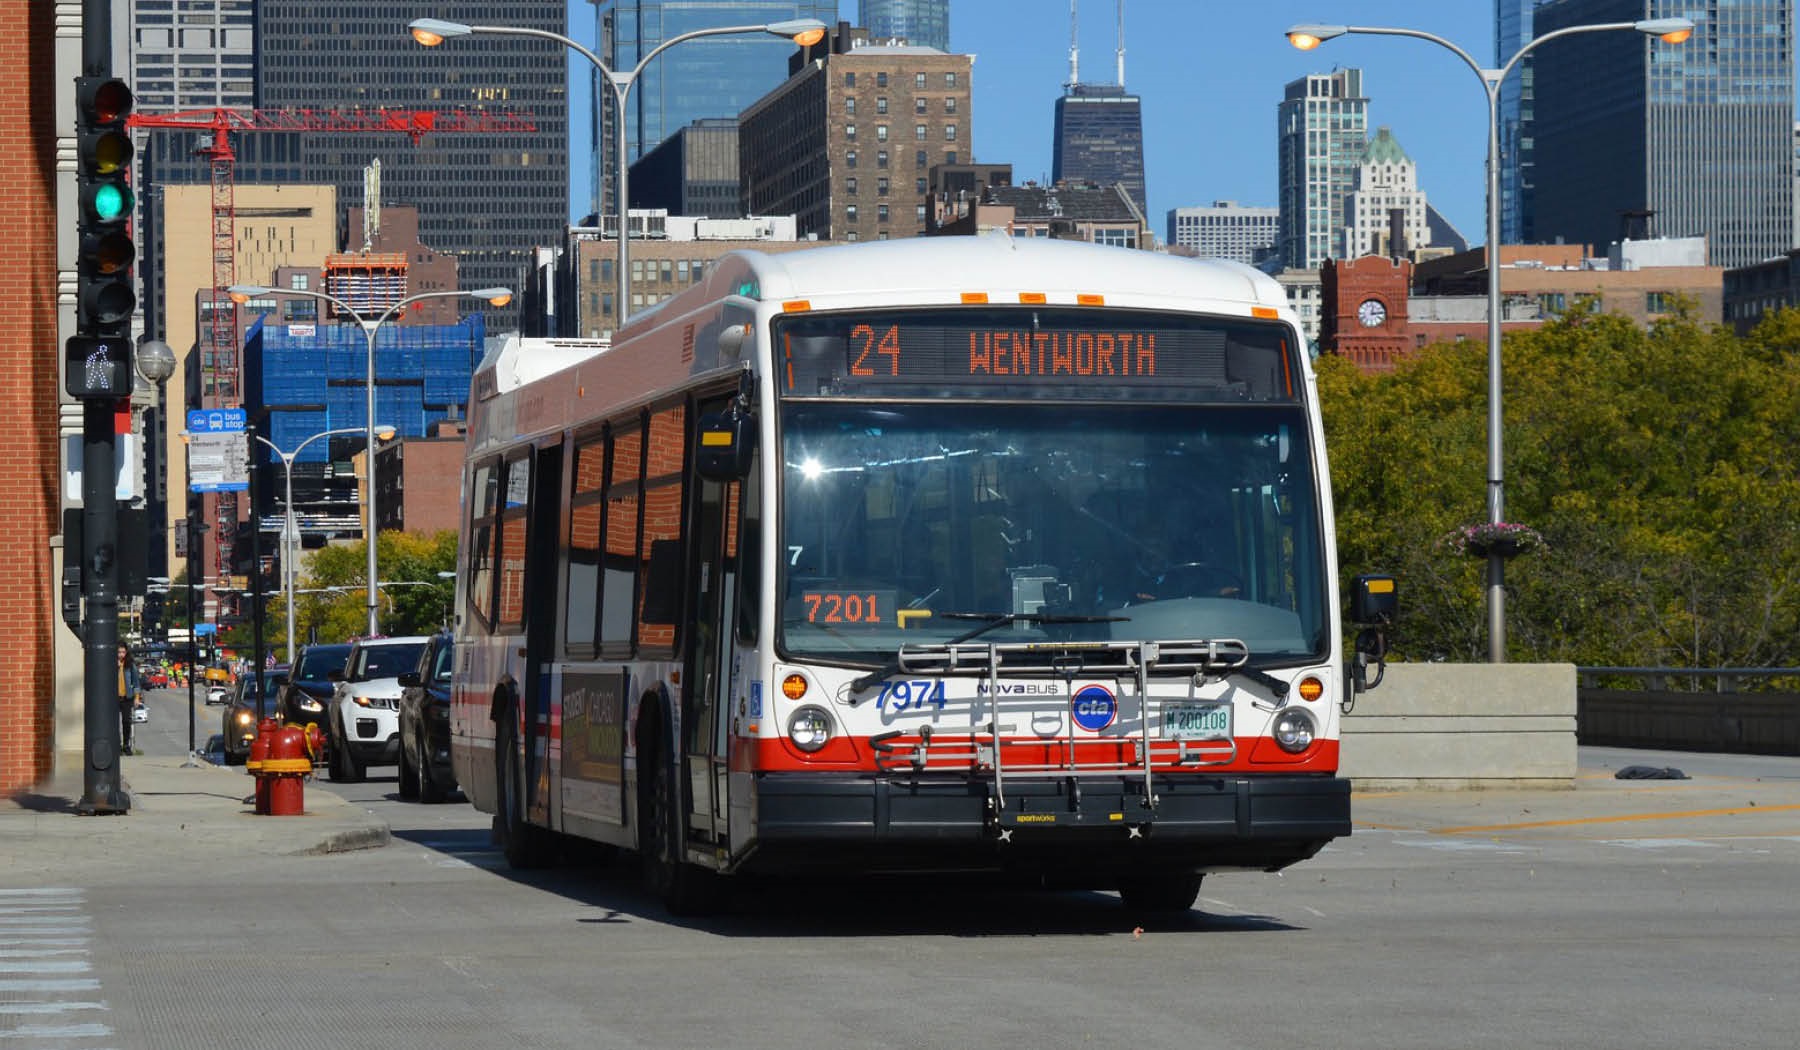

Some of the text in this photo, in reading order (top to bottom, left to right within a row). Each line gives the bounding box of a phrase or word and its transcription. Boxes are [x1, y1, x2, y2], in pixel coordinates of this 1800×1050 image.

[852, 324, 1156, 376] 24 WENTWORTH
[225, 412, 241, 420] bus
[225, 420, 244, 430] stop
[788, 545, 803, 566] 7
[804, 594, 880, 623] 7201
[876, 681, 947, 709] 7974
[1078, 700, 1108, 715] cta
[1179, 711, 1227, 730] 200108
